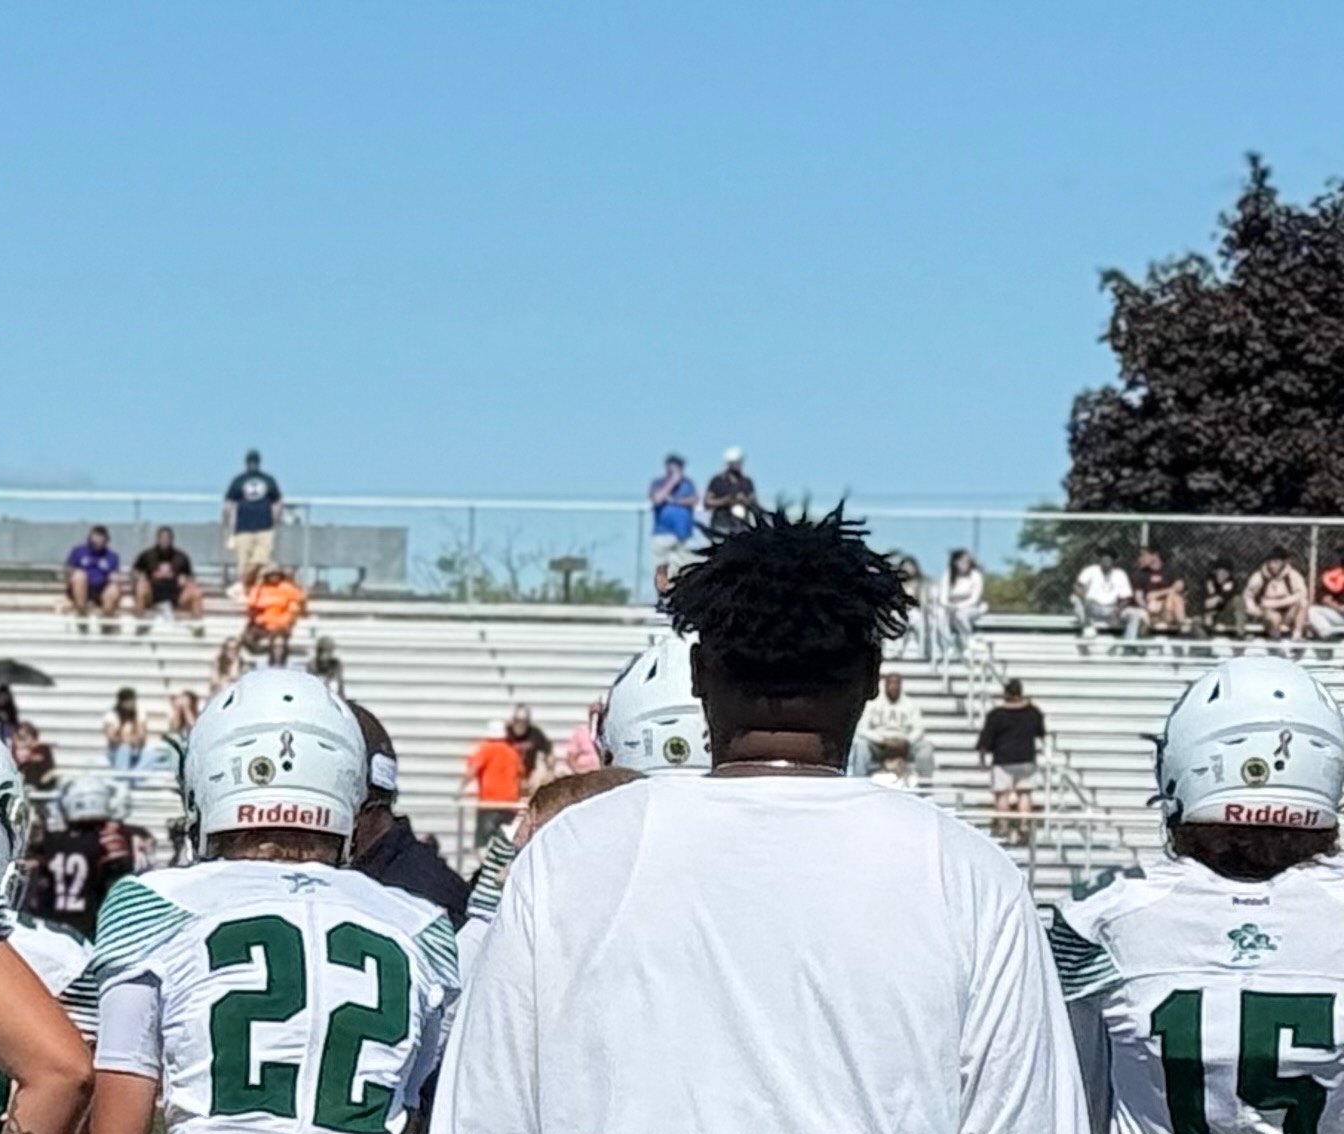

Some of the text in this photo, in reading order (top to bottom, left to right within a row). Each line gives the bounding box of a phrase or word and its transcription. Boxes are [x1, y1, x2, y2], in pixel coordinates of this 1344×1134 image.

[237, 803, 331, 827] Riddell
[1225, 804, 1319, 826] Riddell
[48, 852, 89, 911] 12
